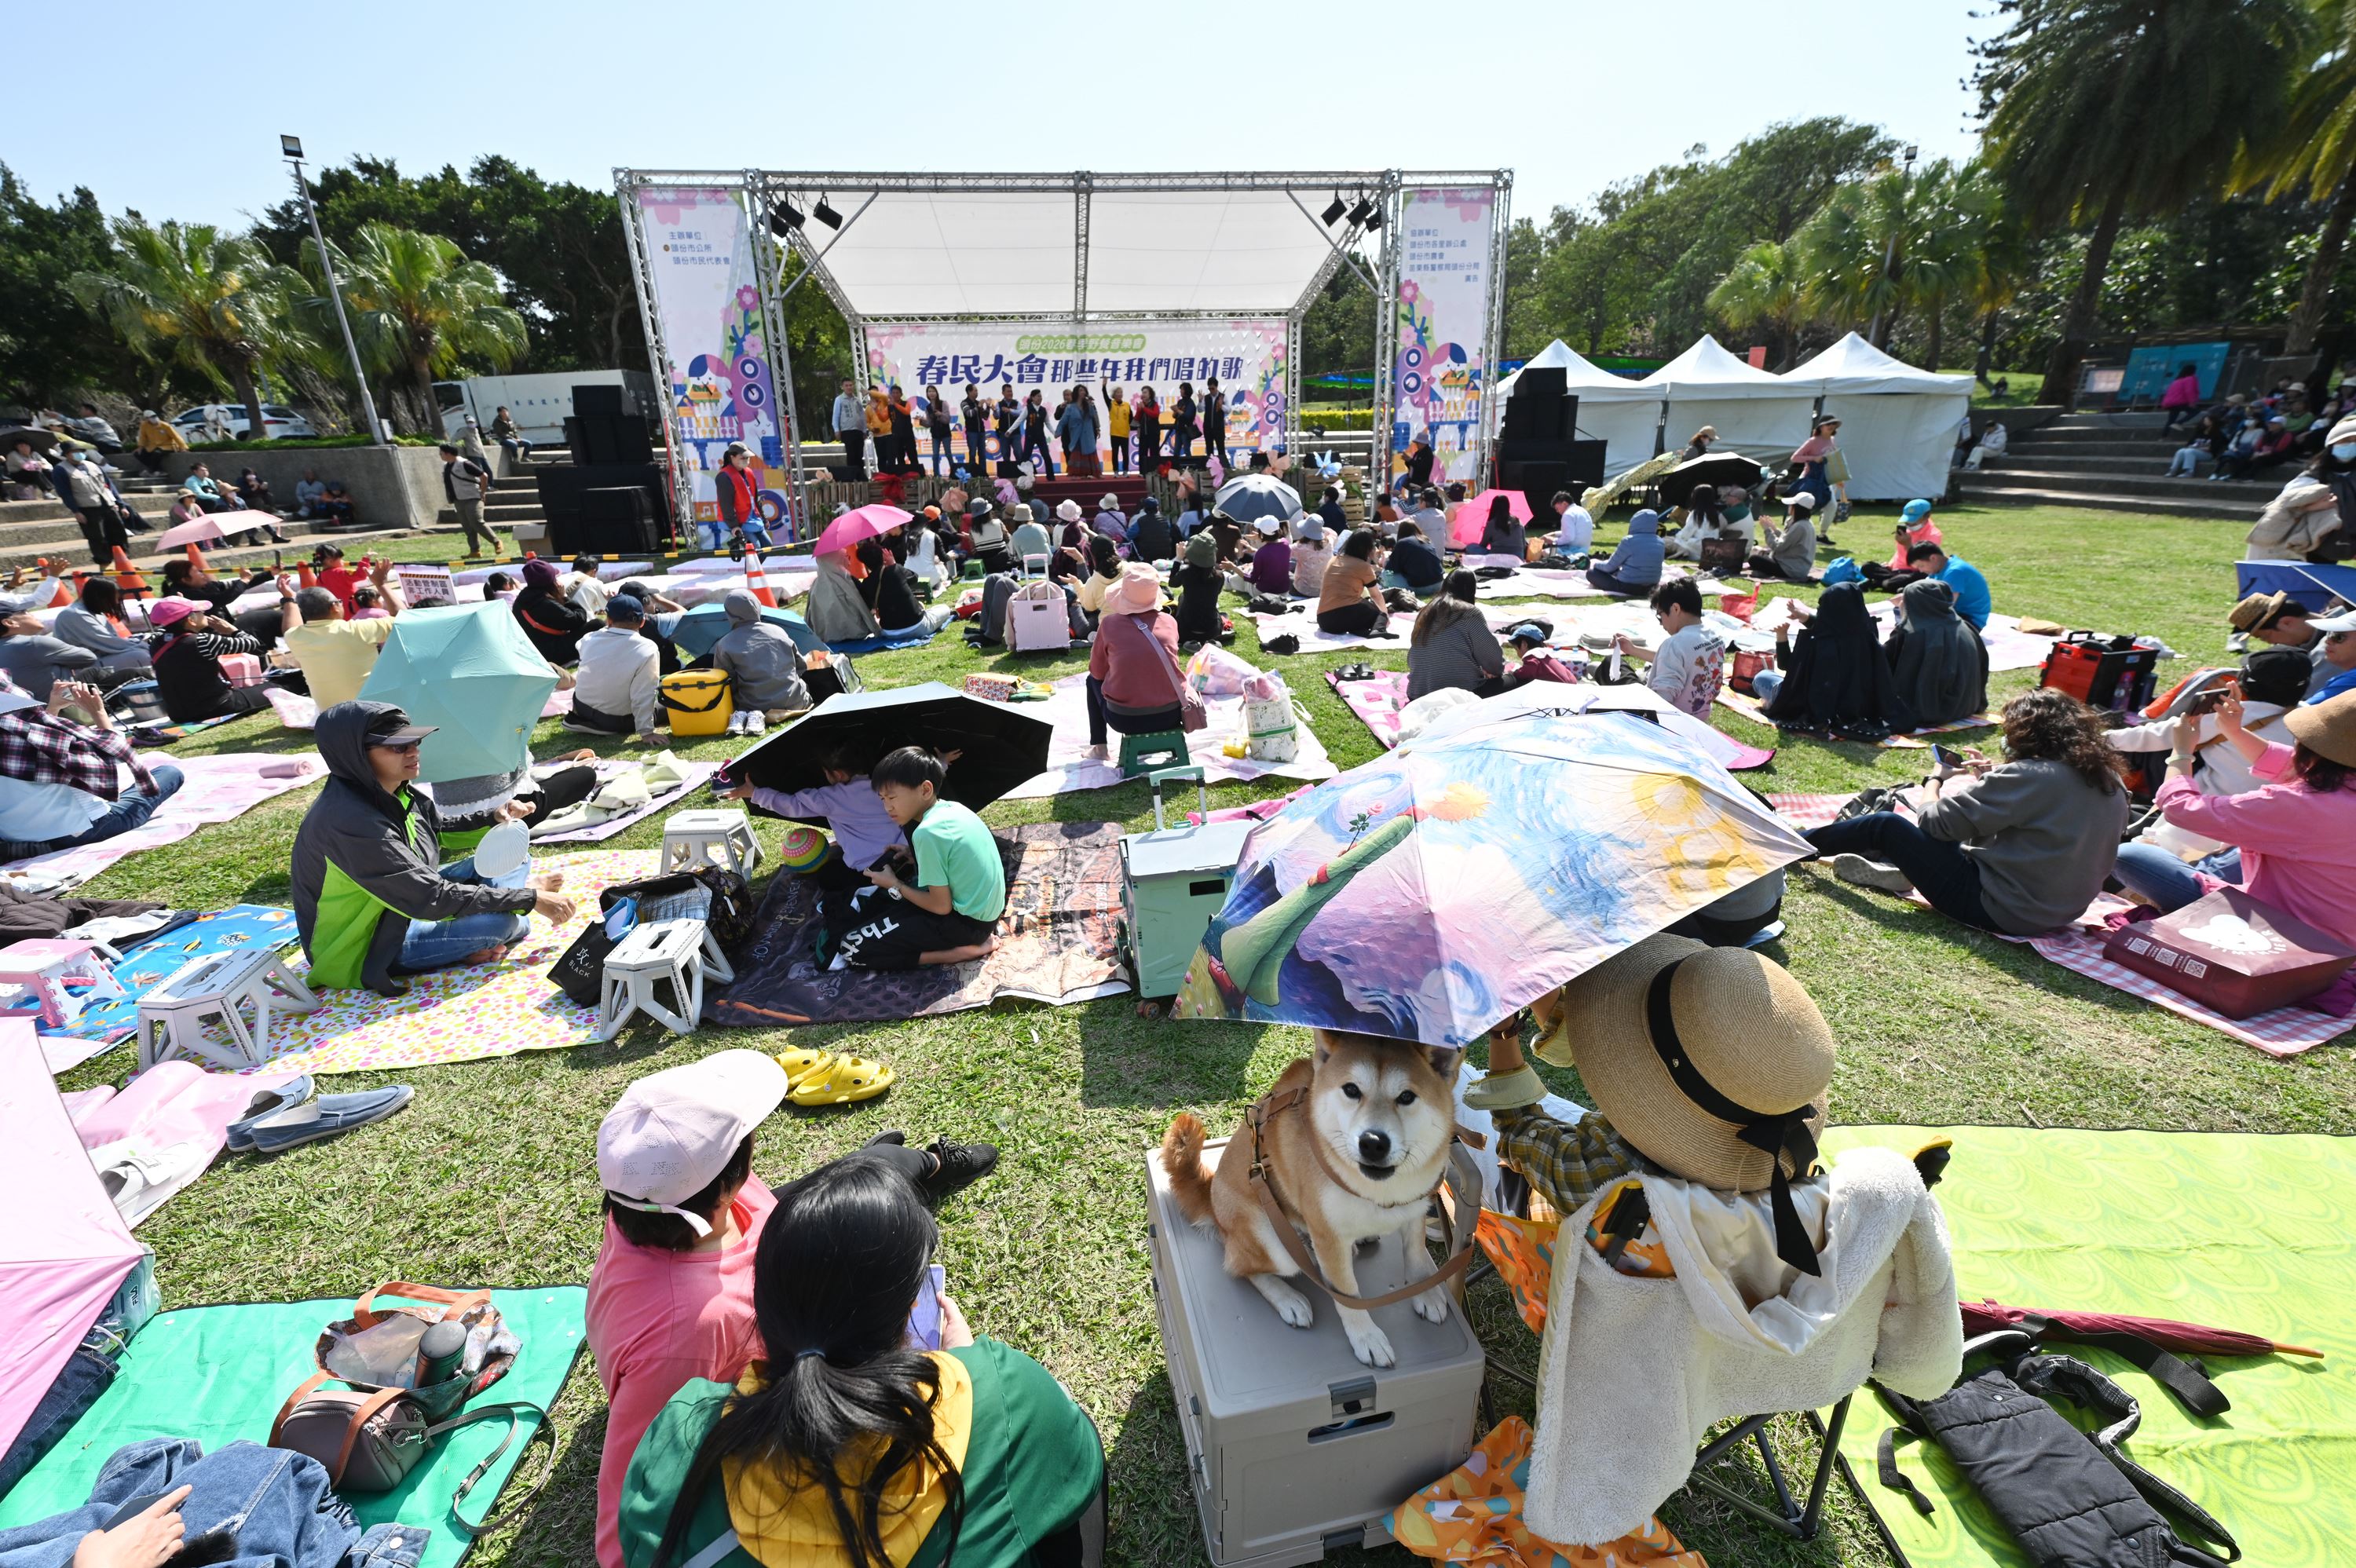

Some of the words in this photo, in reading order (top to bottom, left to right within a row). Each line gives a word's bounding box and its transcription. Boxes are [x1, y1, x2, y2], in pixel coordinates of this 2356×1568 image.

[669, 231, 702, 239] 主辦單位
[671, 243, 712, 253] 頭份市公所
[672, 256, 730, 265] 頭份市民代表會
[916, 353, 1048, 386] 春民大會
[1051, 356, 1243, 382] 那些年我們唱的歌
[408, 587, 449, 595] 非工作人員
[569, 959, 591, 978] BLACK
[130, 1285, 138, 1306] FILA
